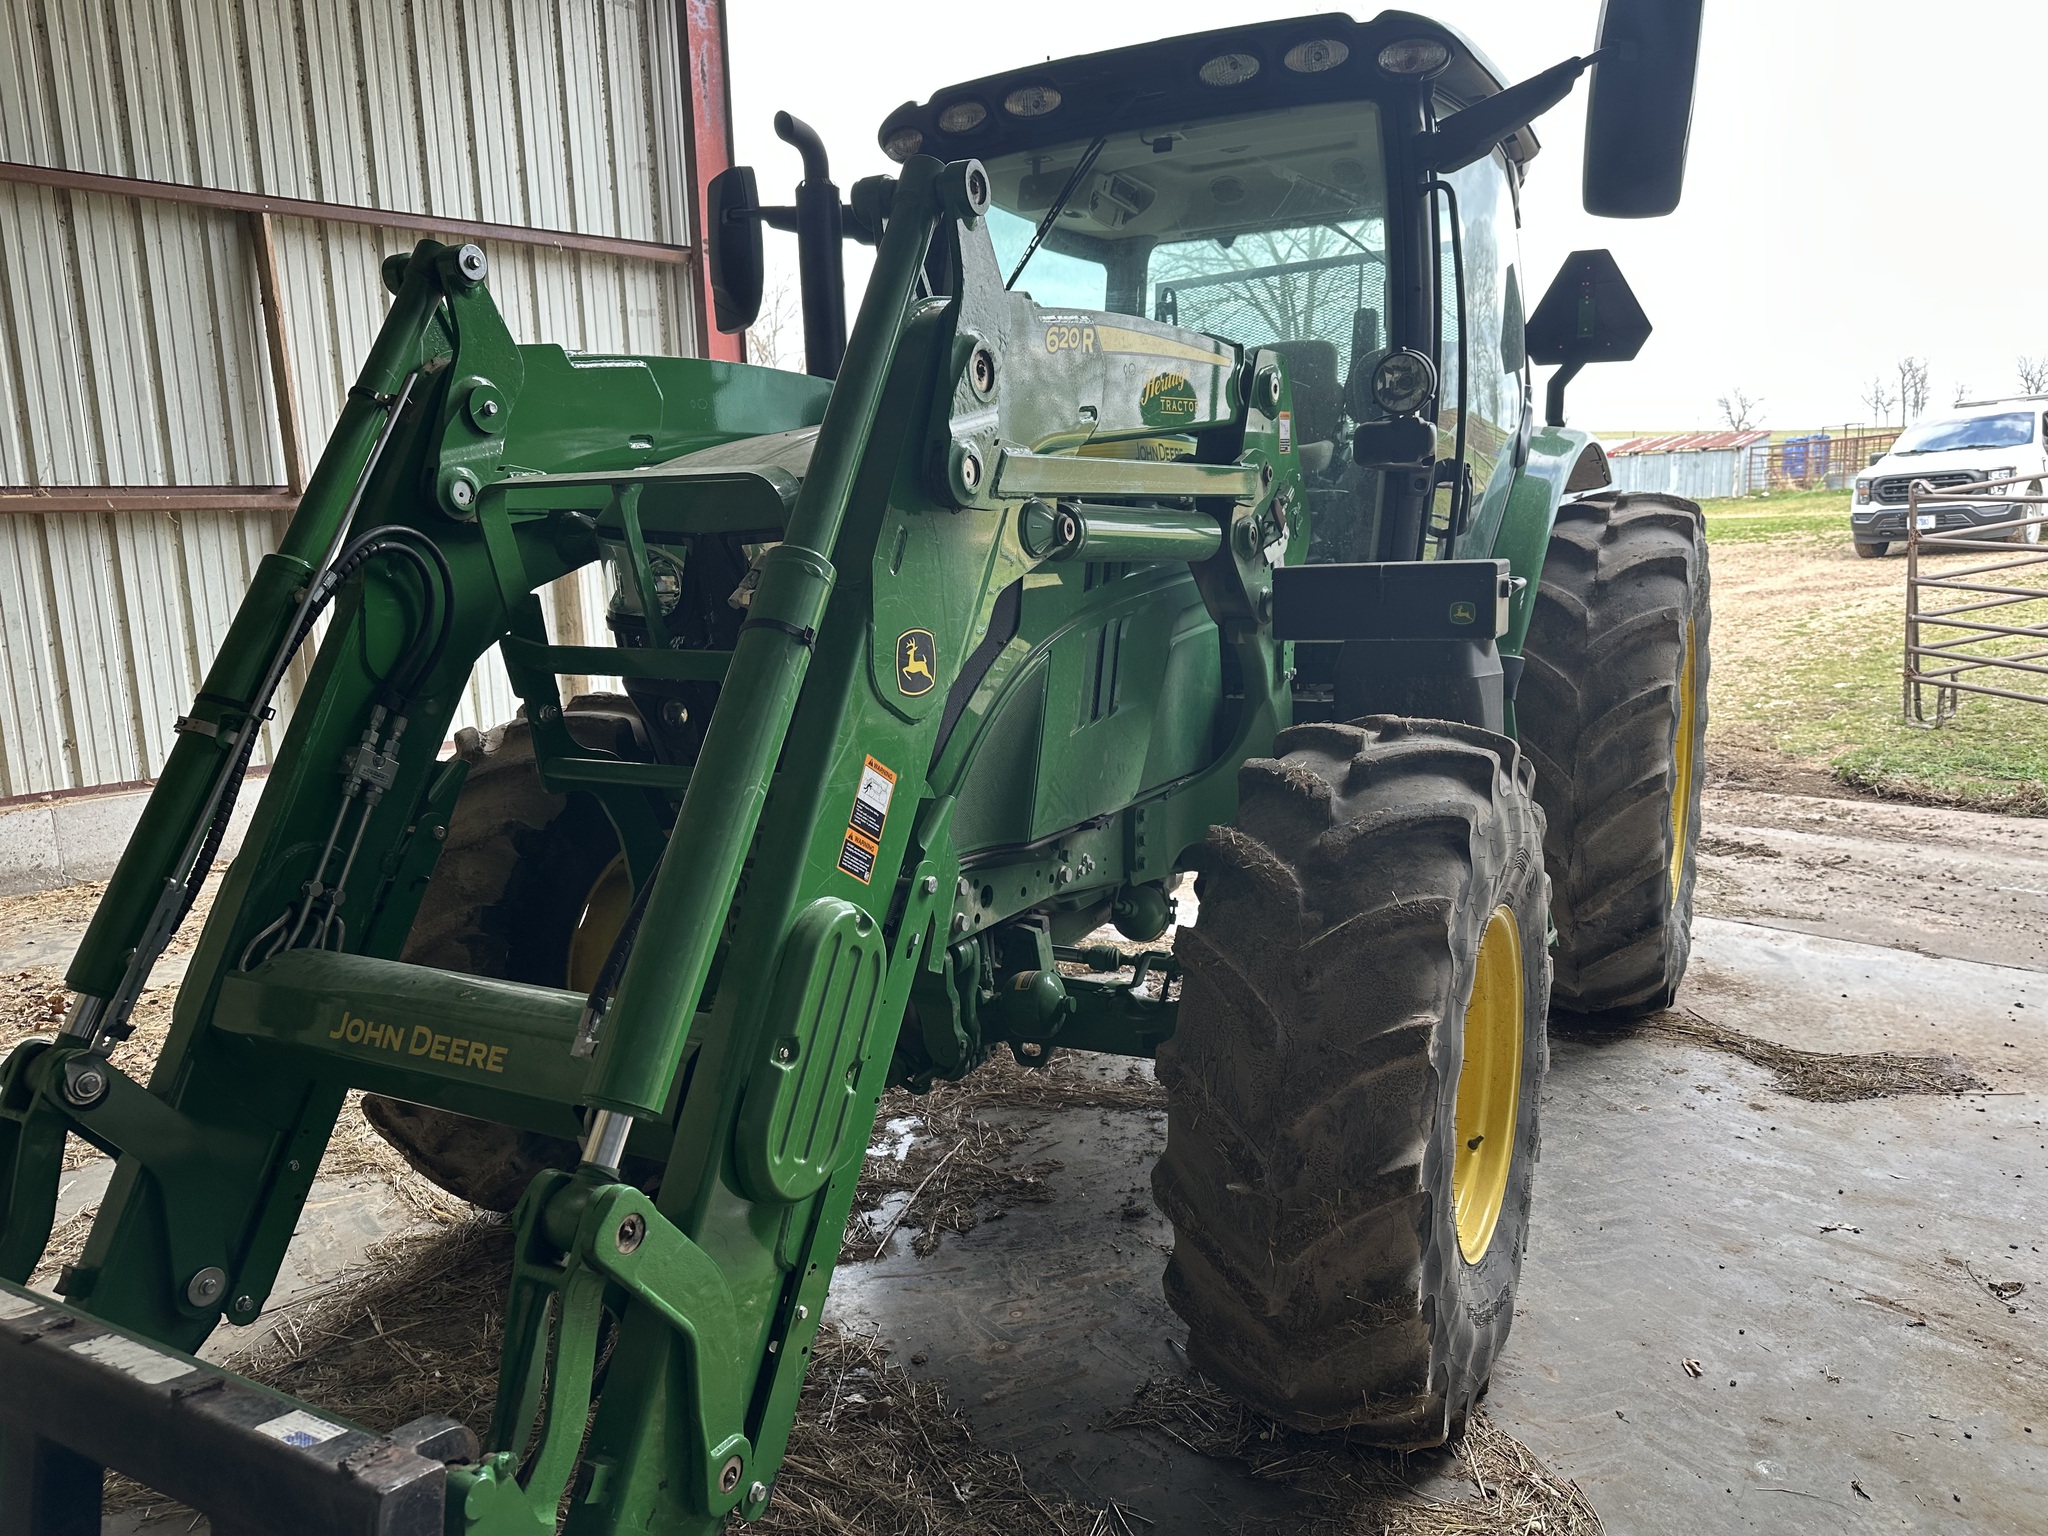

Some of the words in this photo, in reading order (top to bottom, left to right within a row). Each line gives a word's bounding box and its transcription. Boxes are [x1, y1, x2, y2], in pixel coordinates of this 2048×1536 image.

[1135, 441, 1158, 461] JOHN
[329, 1011, 405, 1052] JOHN
[408, 1024, 509, 1073] DEERE
